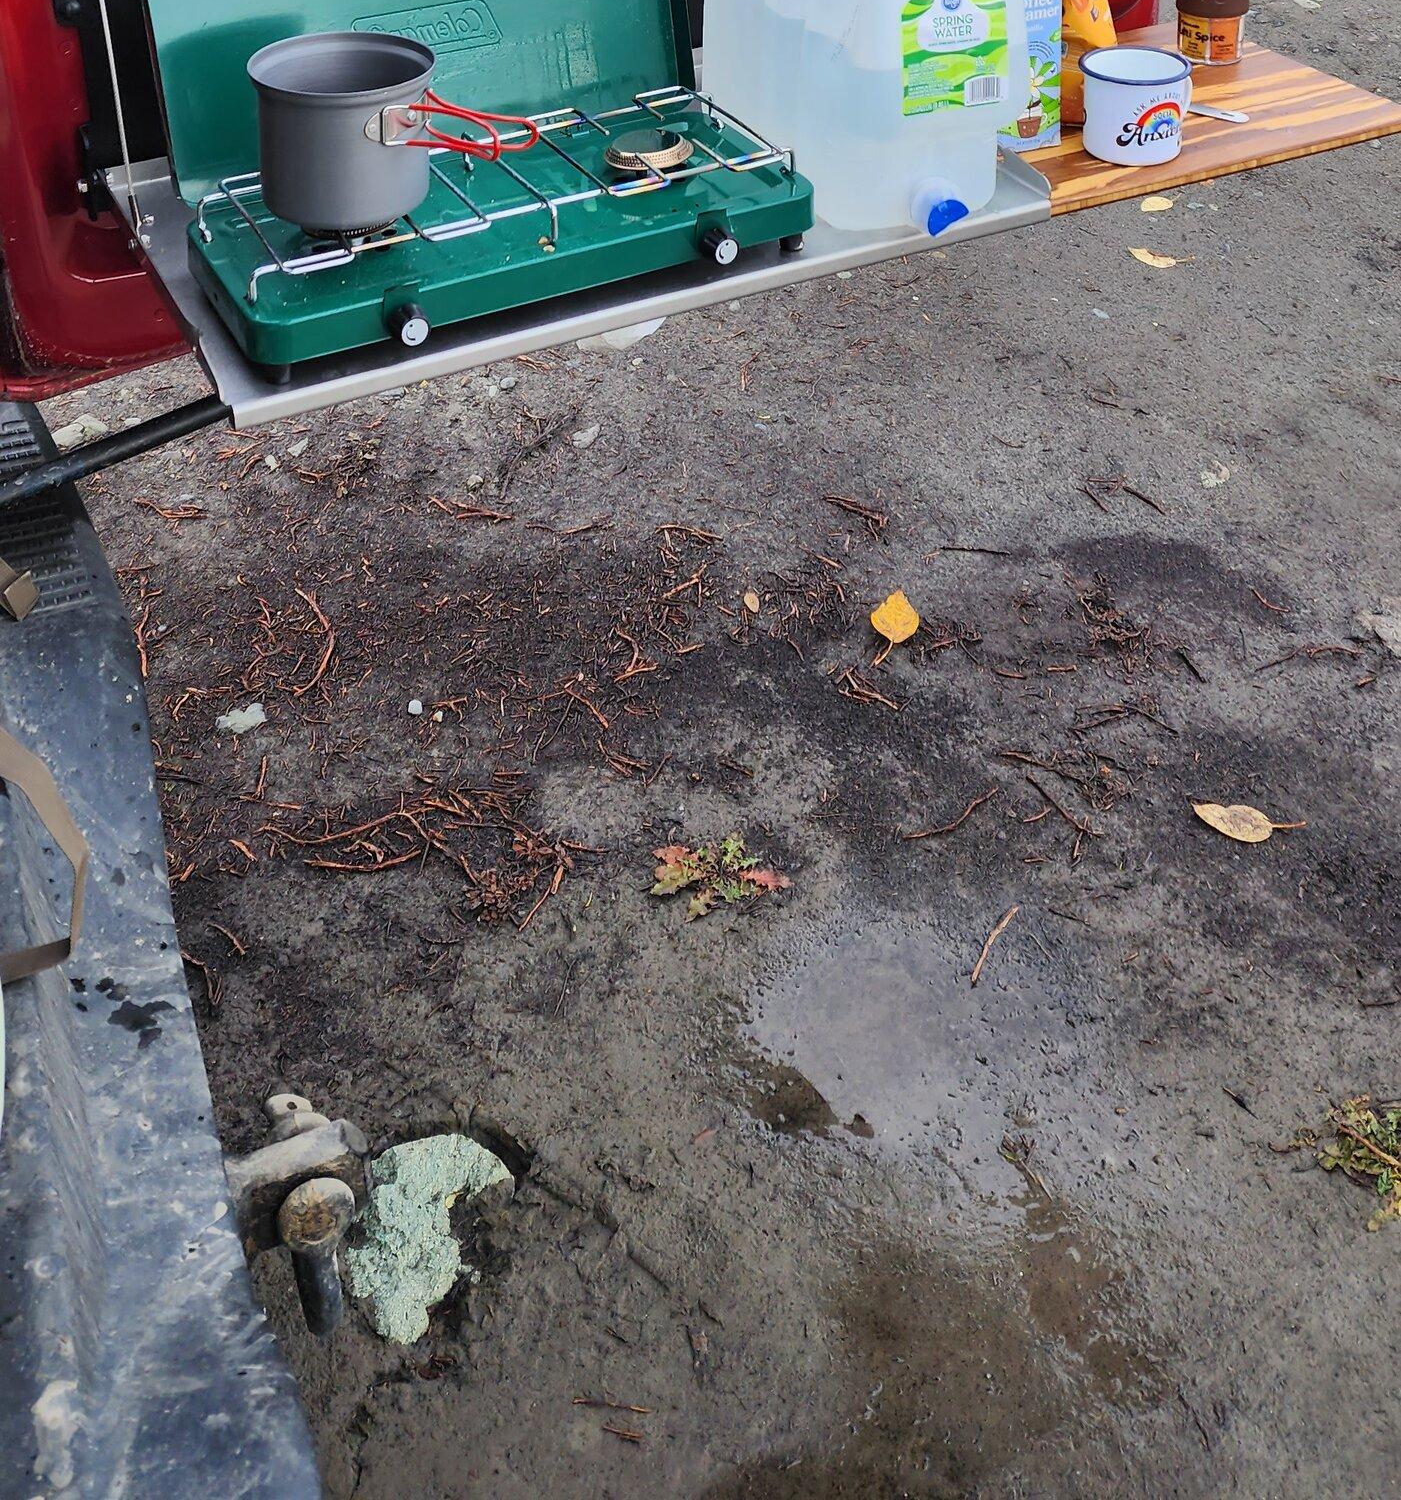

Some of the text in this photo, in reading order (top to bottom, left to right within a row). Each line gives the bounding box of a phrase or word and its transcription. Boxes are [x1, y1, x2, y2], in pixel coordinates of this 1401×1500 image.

[1025, 6, 1060, 21] amer
[933, 14, 973, 29] SPRING
[935, 26, 973, 39] WATER
[1195, 31, 1225, 43] Spice
